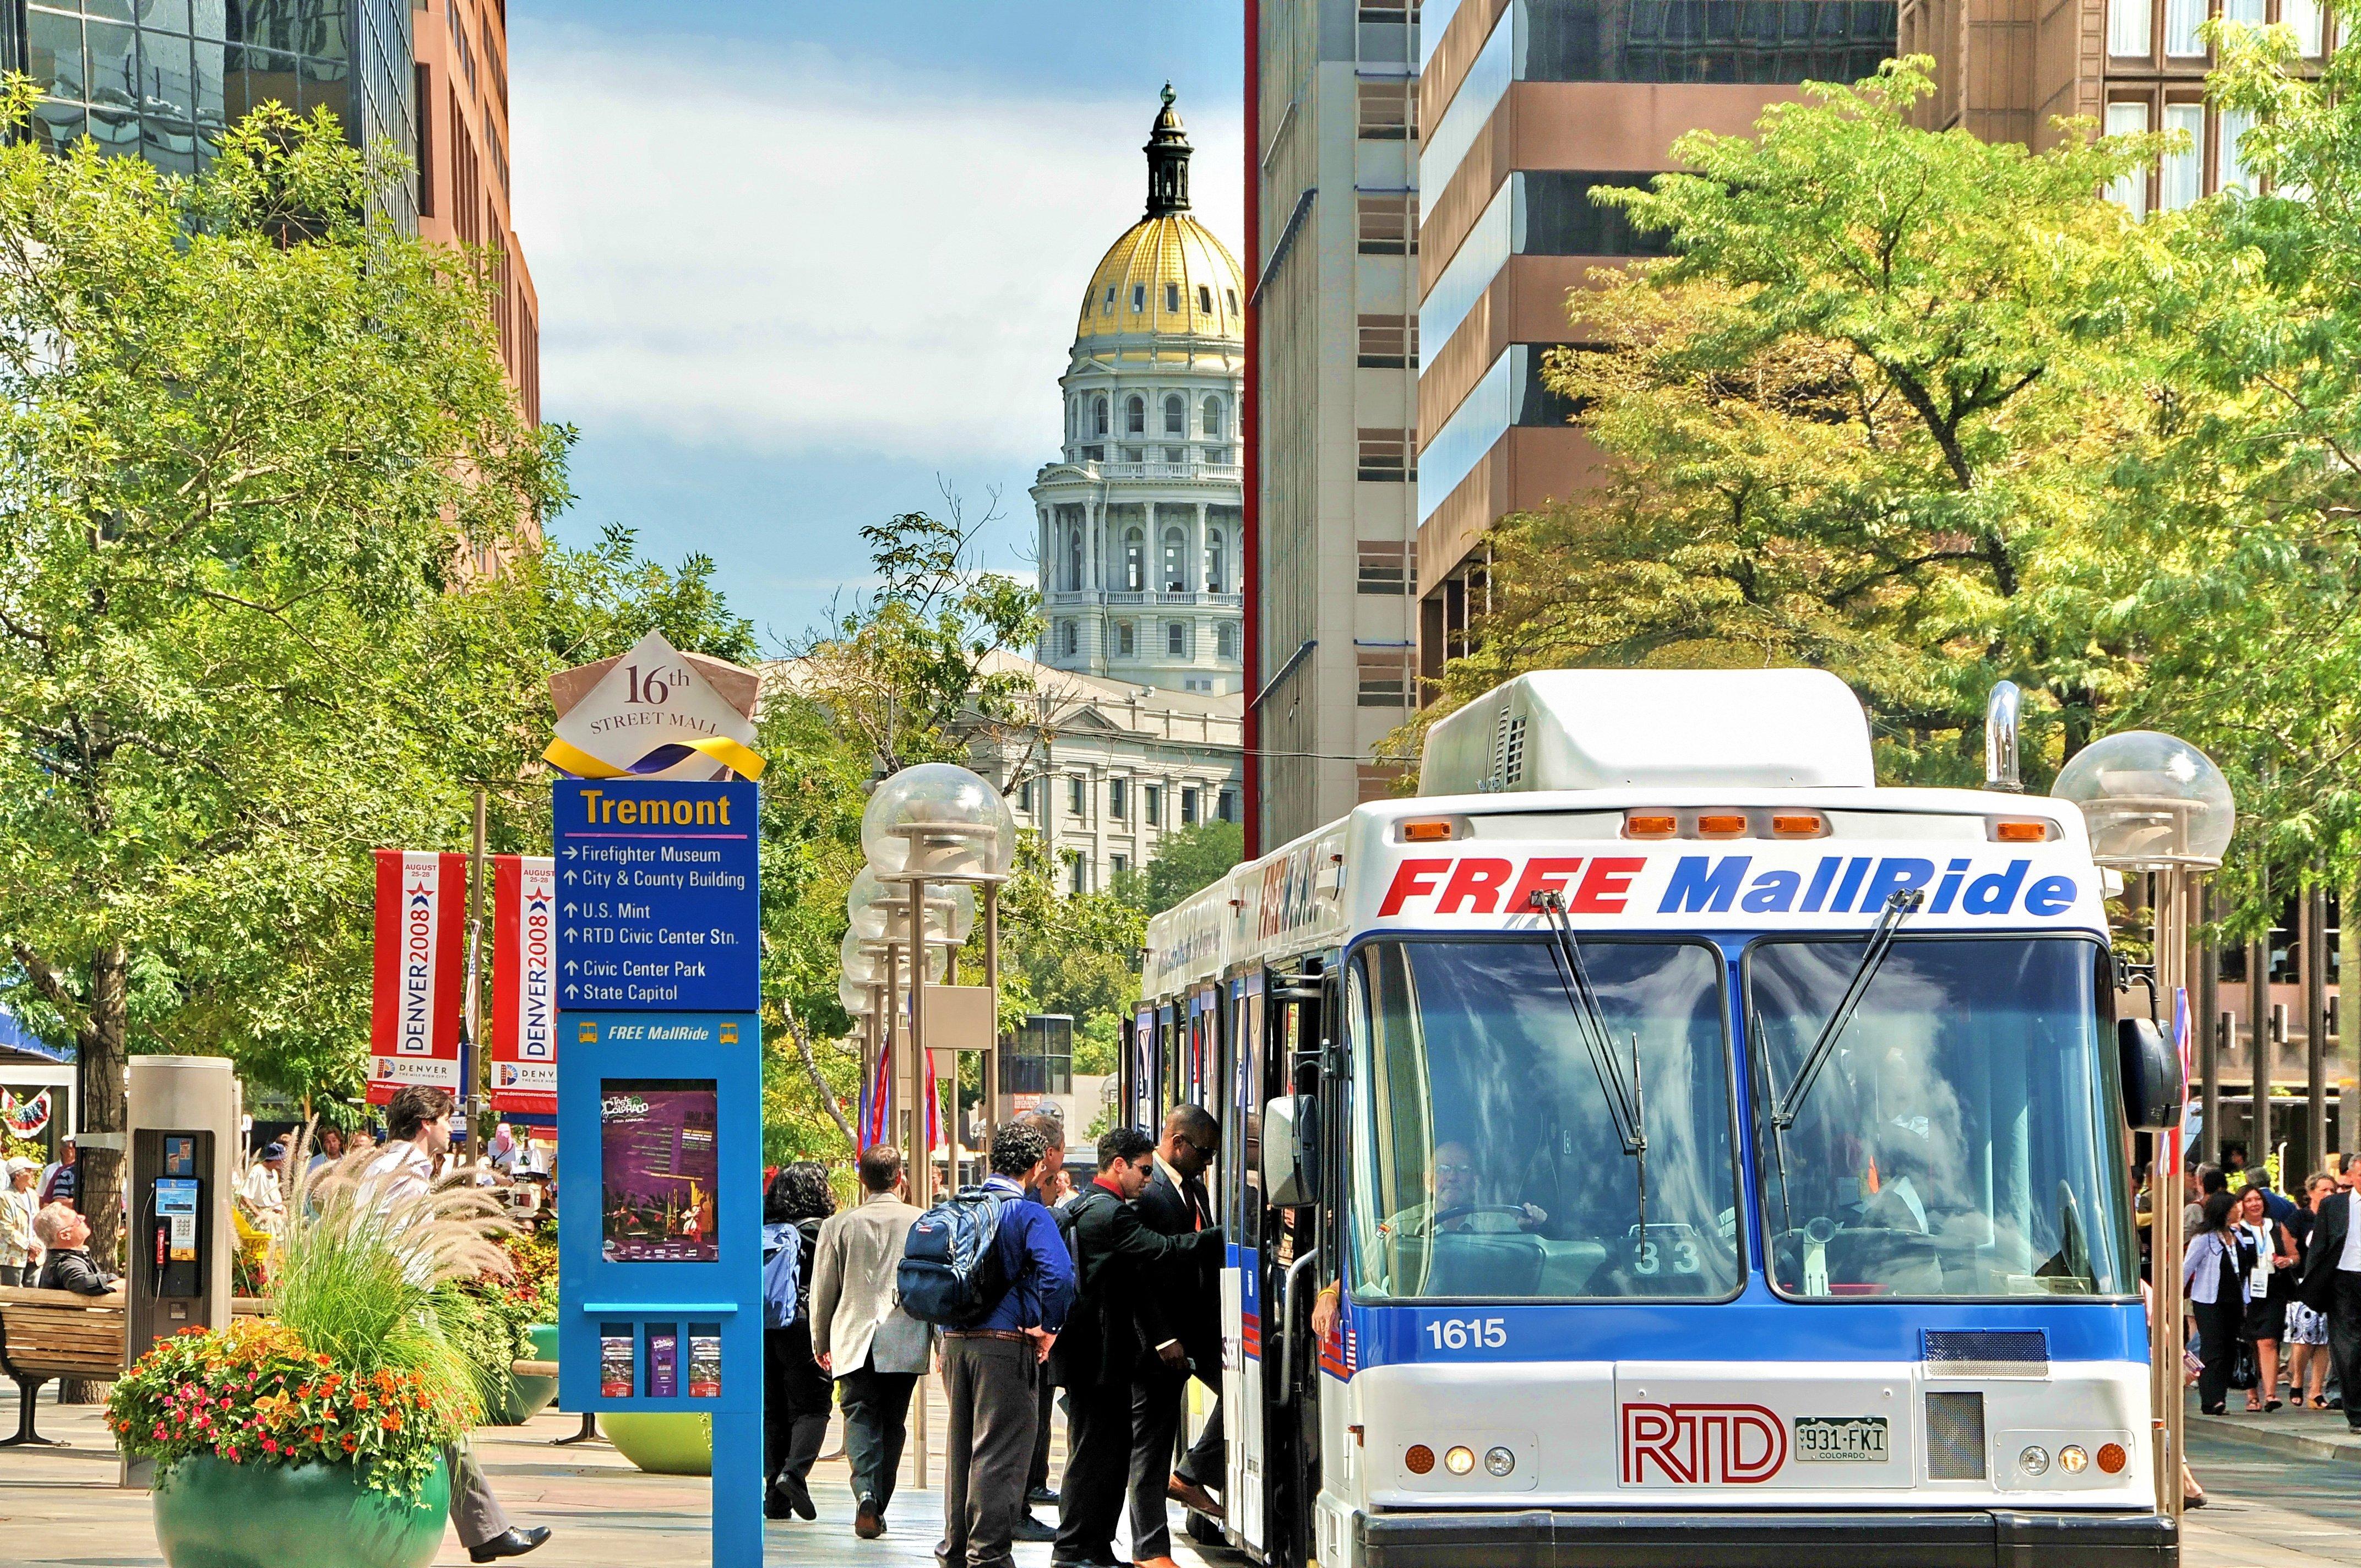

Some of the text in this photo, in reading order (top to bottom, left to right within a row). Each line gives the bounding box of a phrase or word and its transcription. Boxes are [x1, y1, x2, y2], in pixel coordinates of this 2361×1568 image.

[624, 665, 690, 705] 16th
[590, 711, 721, 737] STREET MALL
[580, 790, 731, 825] Tremont
[583, 846, 721, 865] Firefighter Museum
[405, 864, 437, 872] AUGUST
[524, 869, 555, 878] AUGUST
[583, 870, 746, 891] City & County Building
[1377, 857, 1648, 918] FREE
[1657, 856, 2077, 917] MallRide
[583, 902, 650, 919] U.S. Mint
[584, 928, 739, 945] RTD Civic Center Stn.
[584, 960, 705, 977] Civic Center Park
[406, 910, 429, 1051] DENVER2008
[526, 915, 548, 1057] DENVER2008
[584, 984, 678, 1003] State Capitol
[608, 1026, 709, 1041] FREE MallRide
[399, 1064, 447, 1074] DENVER
[603, 1100, 649, 1114] COLORADO
[612, 1096, 631, 1106] TASTE
[1427, 1318, 1506, 1349] 1615
[1622, 1403, 1787, 1483] RTD
